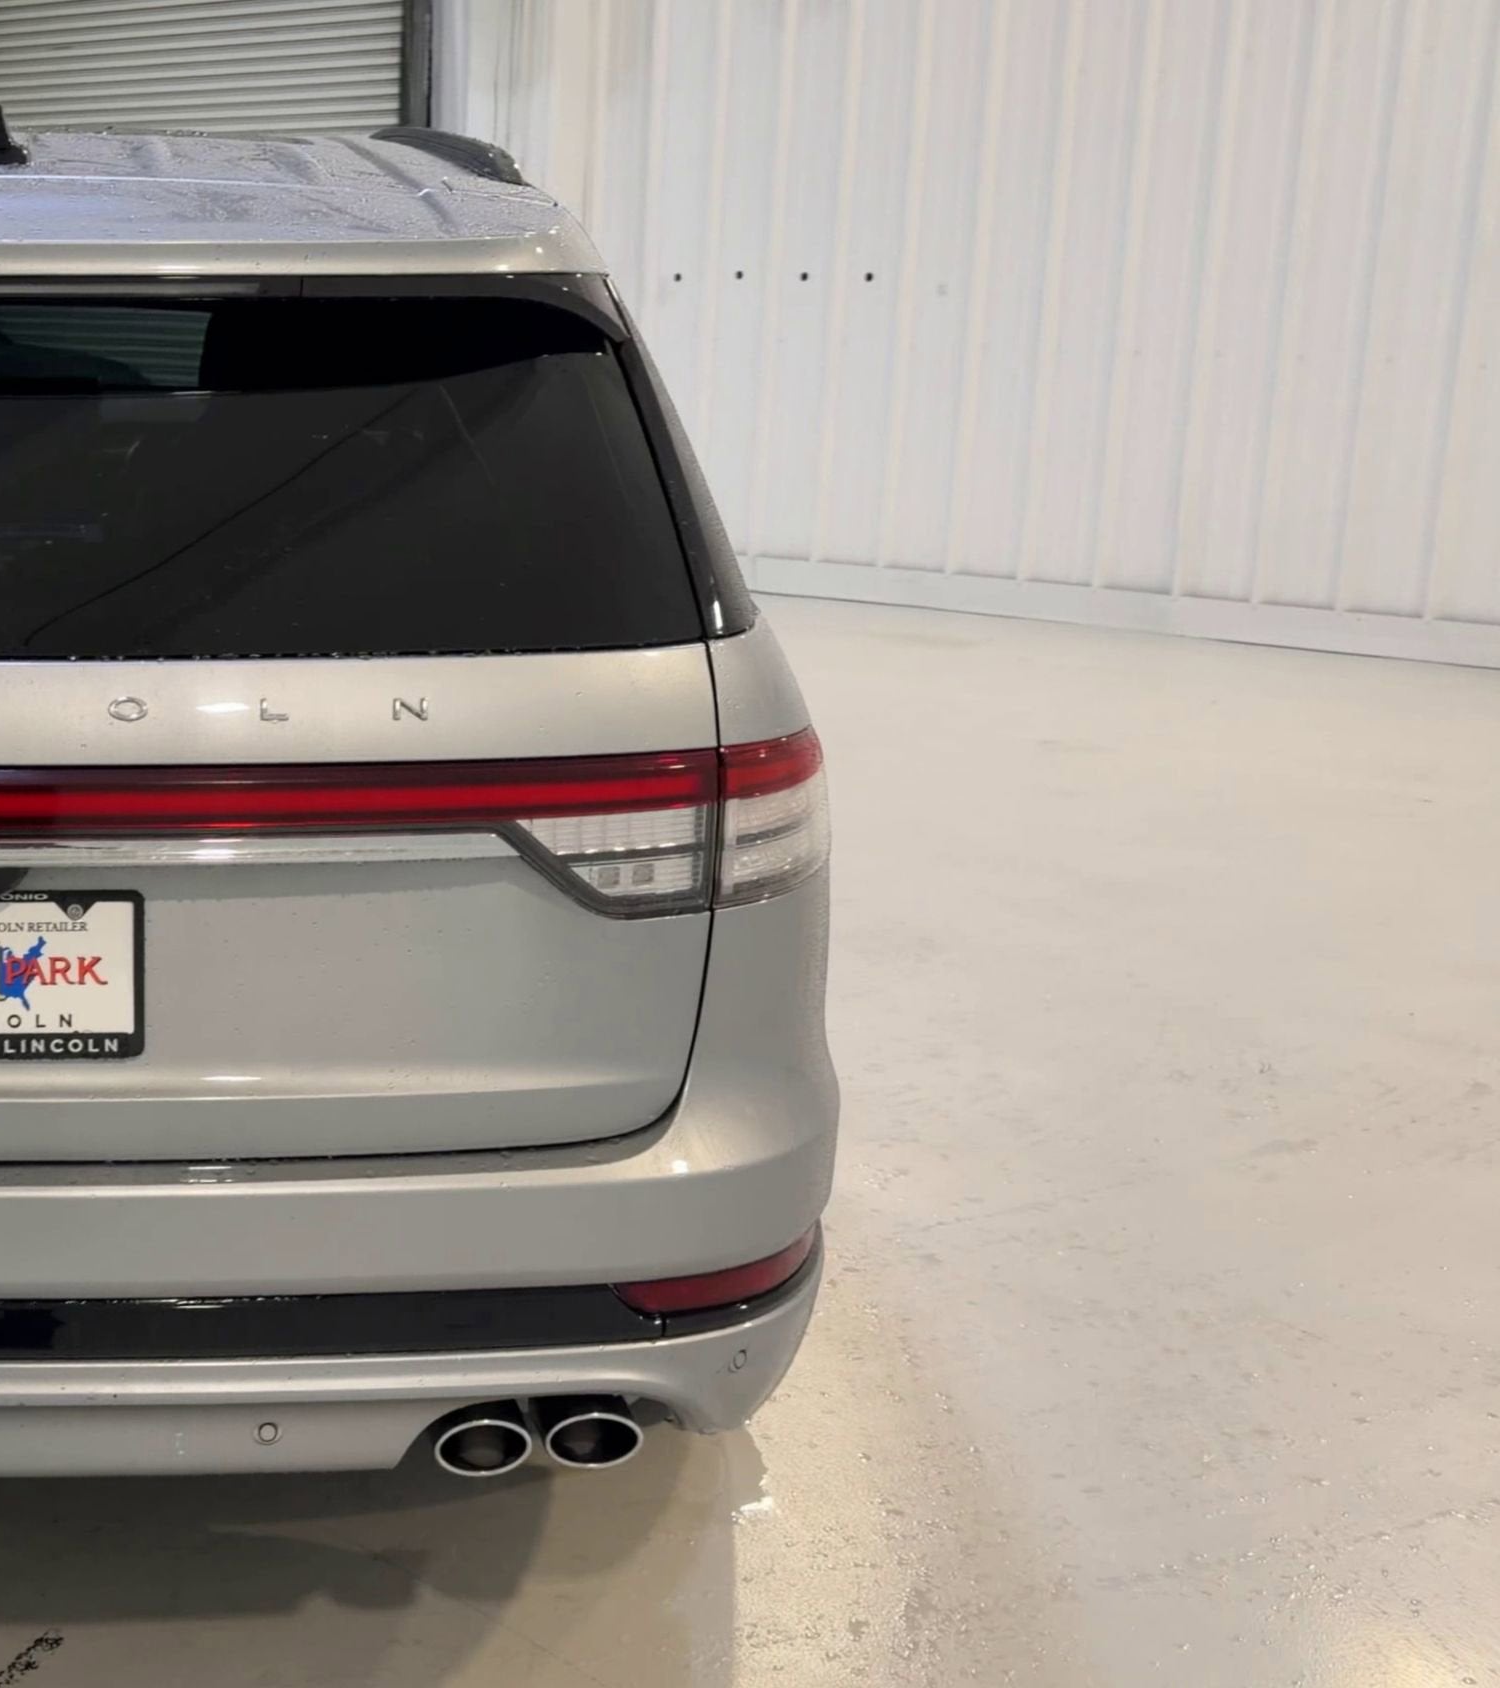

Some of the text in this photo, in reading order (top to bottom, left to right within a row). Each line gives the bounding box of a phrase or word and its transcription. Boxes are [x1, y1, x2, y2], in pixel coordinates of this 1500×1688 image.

[28, 921, 88, 932] RETAILER
[5, 956, 108, 986] PARK
[4, 1038, 119, 1053] LINCOLN
